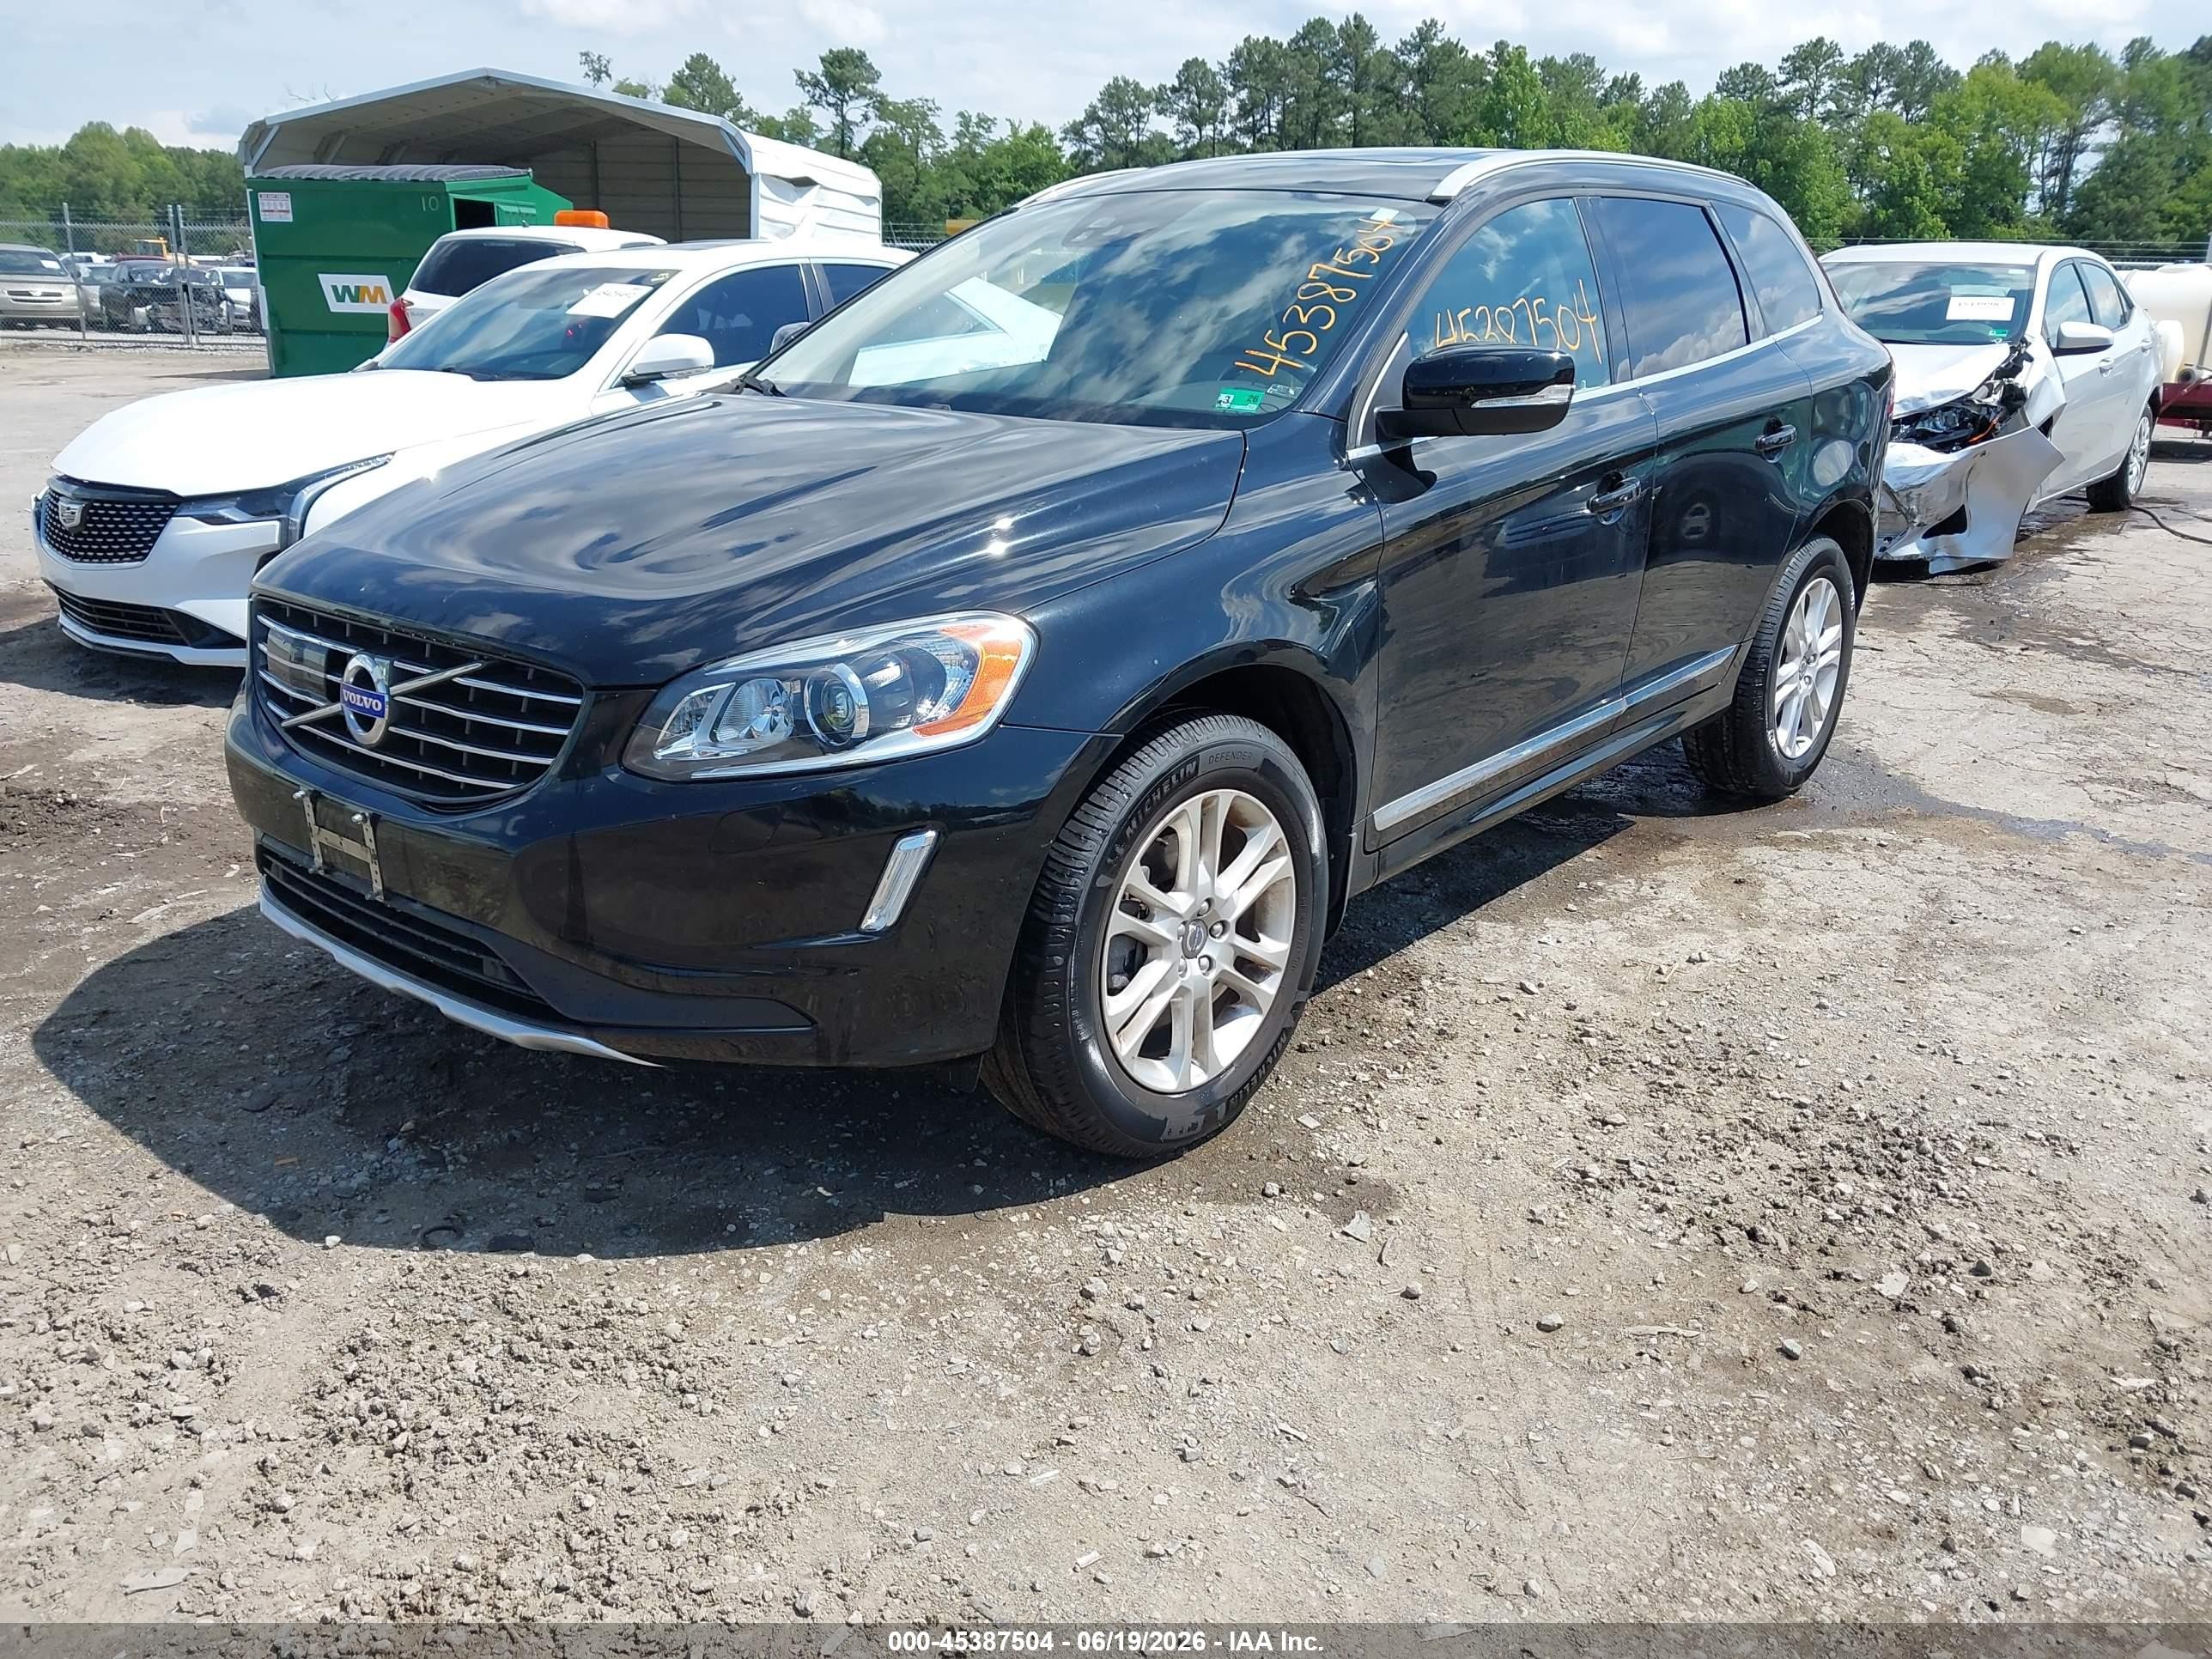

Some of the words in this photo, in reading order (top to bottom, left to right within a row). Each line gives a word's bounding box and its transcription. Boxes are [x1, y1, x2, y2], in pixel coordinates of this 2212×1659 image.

[331, 284, 387, 304] WM
[1234, 216, 1405, 377] 45387504
[1246, 394, 1260, 403] 26
[343, 688, 383, 712] VOLVO
[1208, 750, 1254, 764] DEFENDER
[1125, 759, 1198, 839] MICHELIN
[1229, 1030, 1287, 1104] MICHELIN
